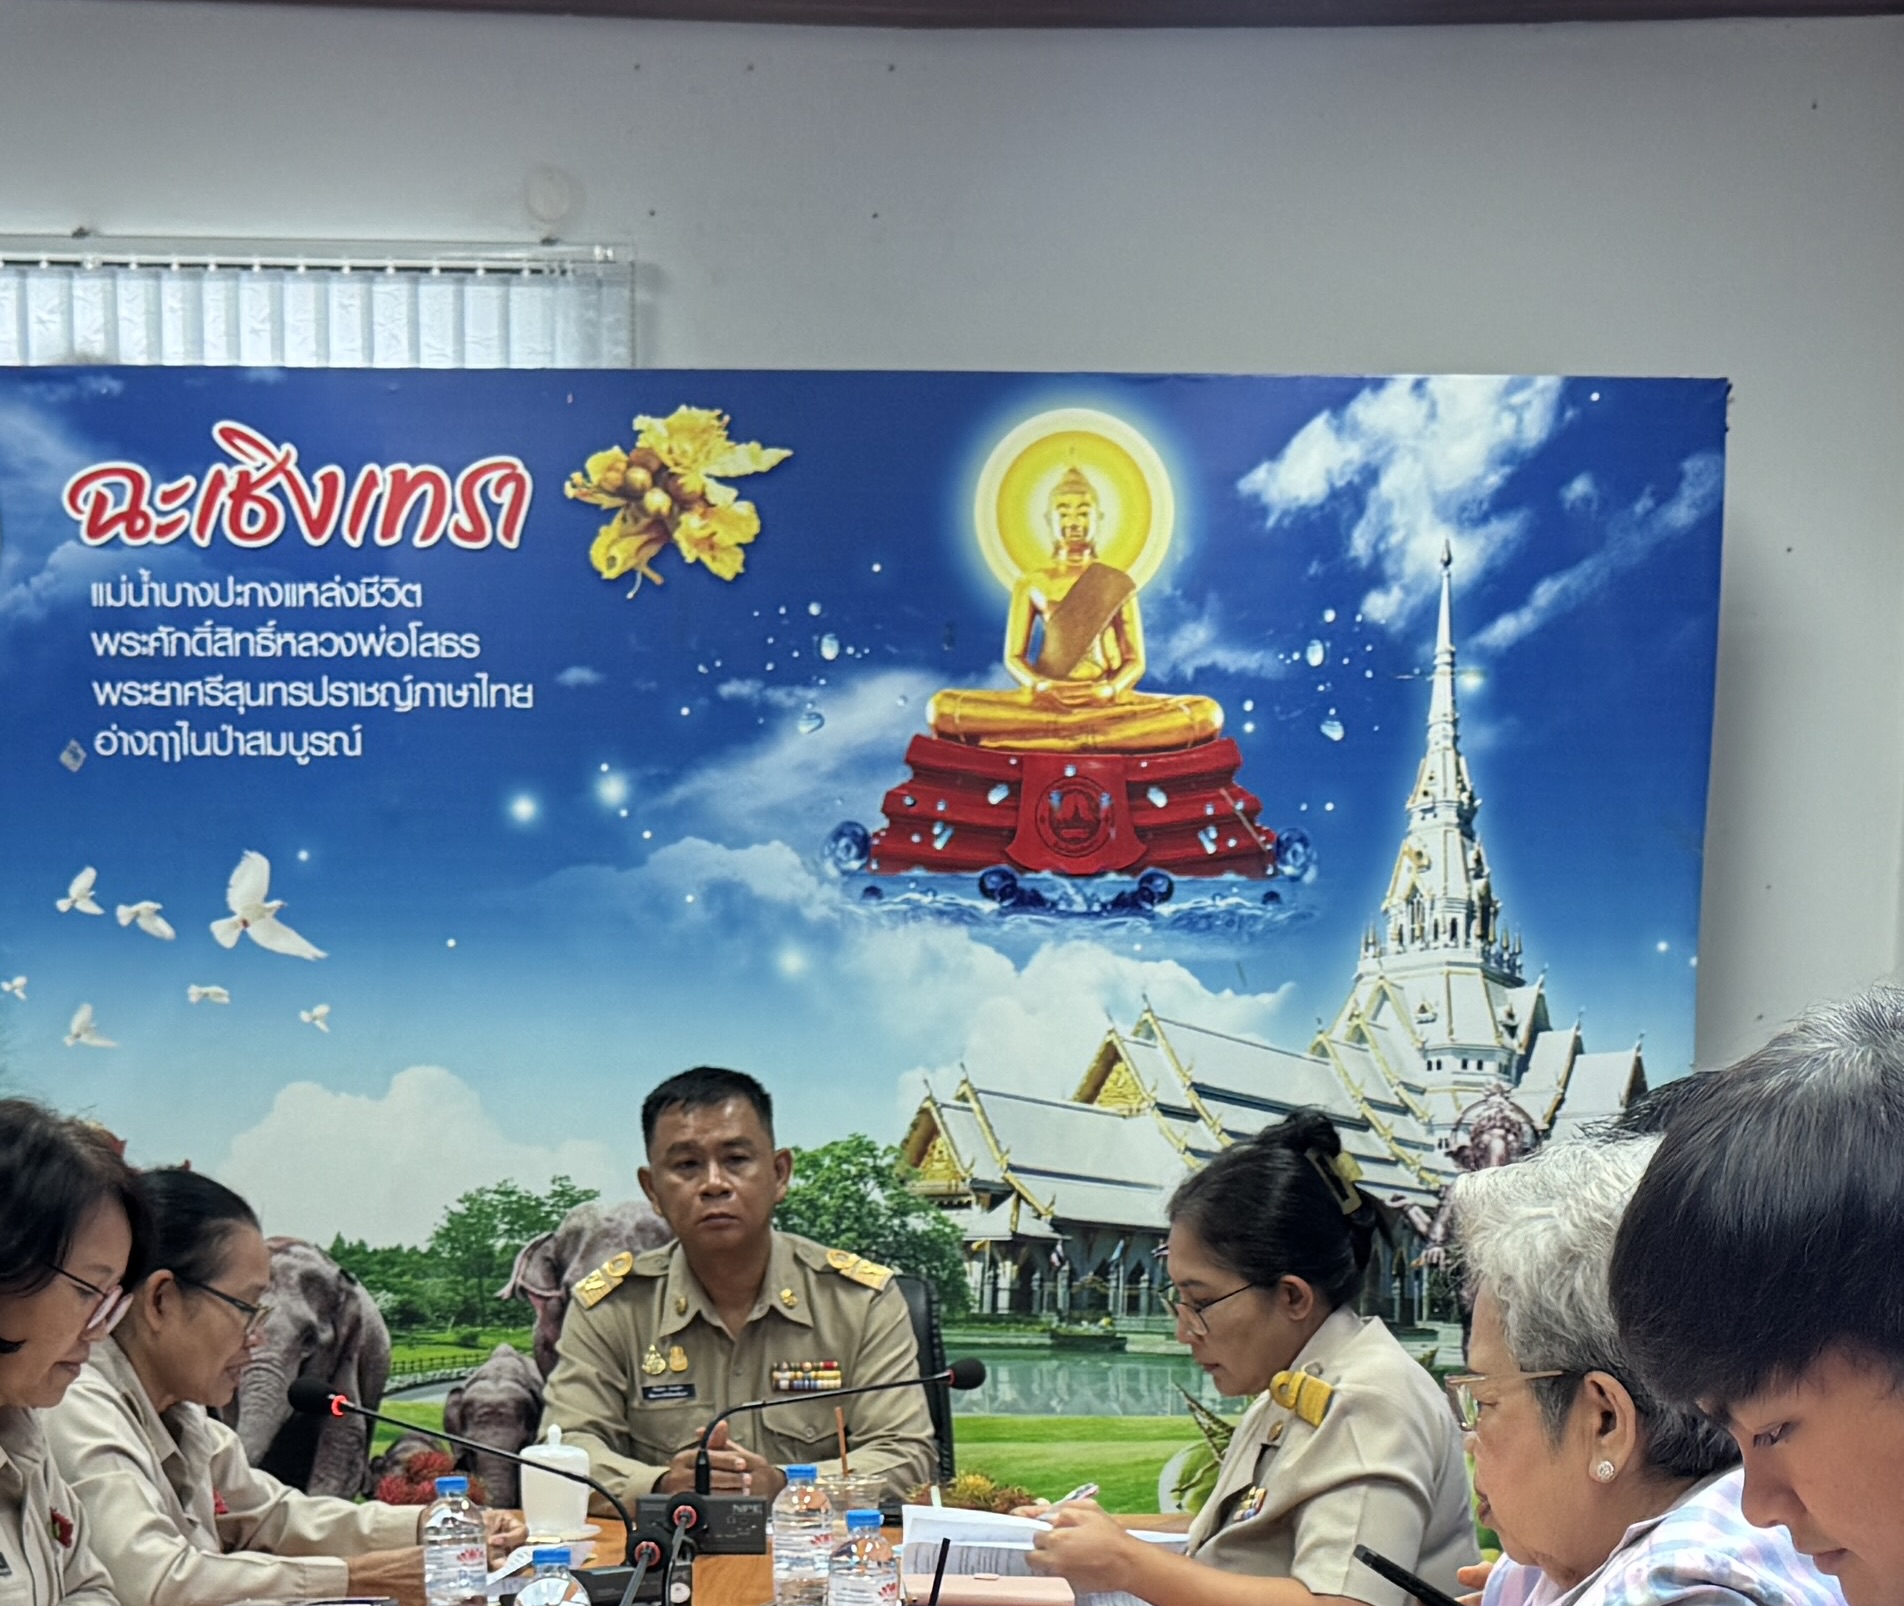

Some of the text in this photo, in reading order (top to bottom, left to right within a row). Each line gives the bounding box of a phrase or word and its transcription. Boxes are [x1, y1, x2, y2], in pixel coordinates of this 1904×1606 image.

[65, 422, 530, 546] ฉะเชิงเทรา
[91, 568, 423, 608] แม่น้ำบางปะกงแหล่งชีวิต
[90, 619, 481, 659] พระศักดิ์สิทธิ์หลวงพ่อโสธร
[91, 672, 534, 715] พระยาศรีสุนทรปราชญ์ภาษาไทย
[732, 1504, 763, 1515] NPE
